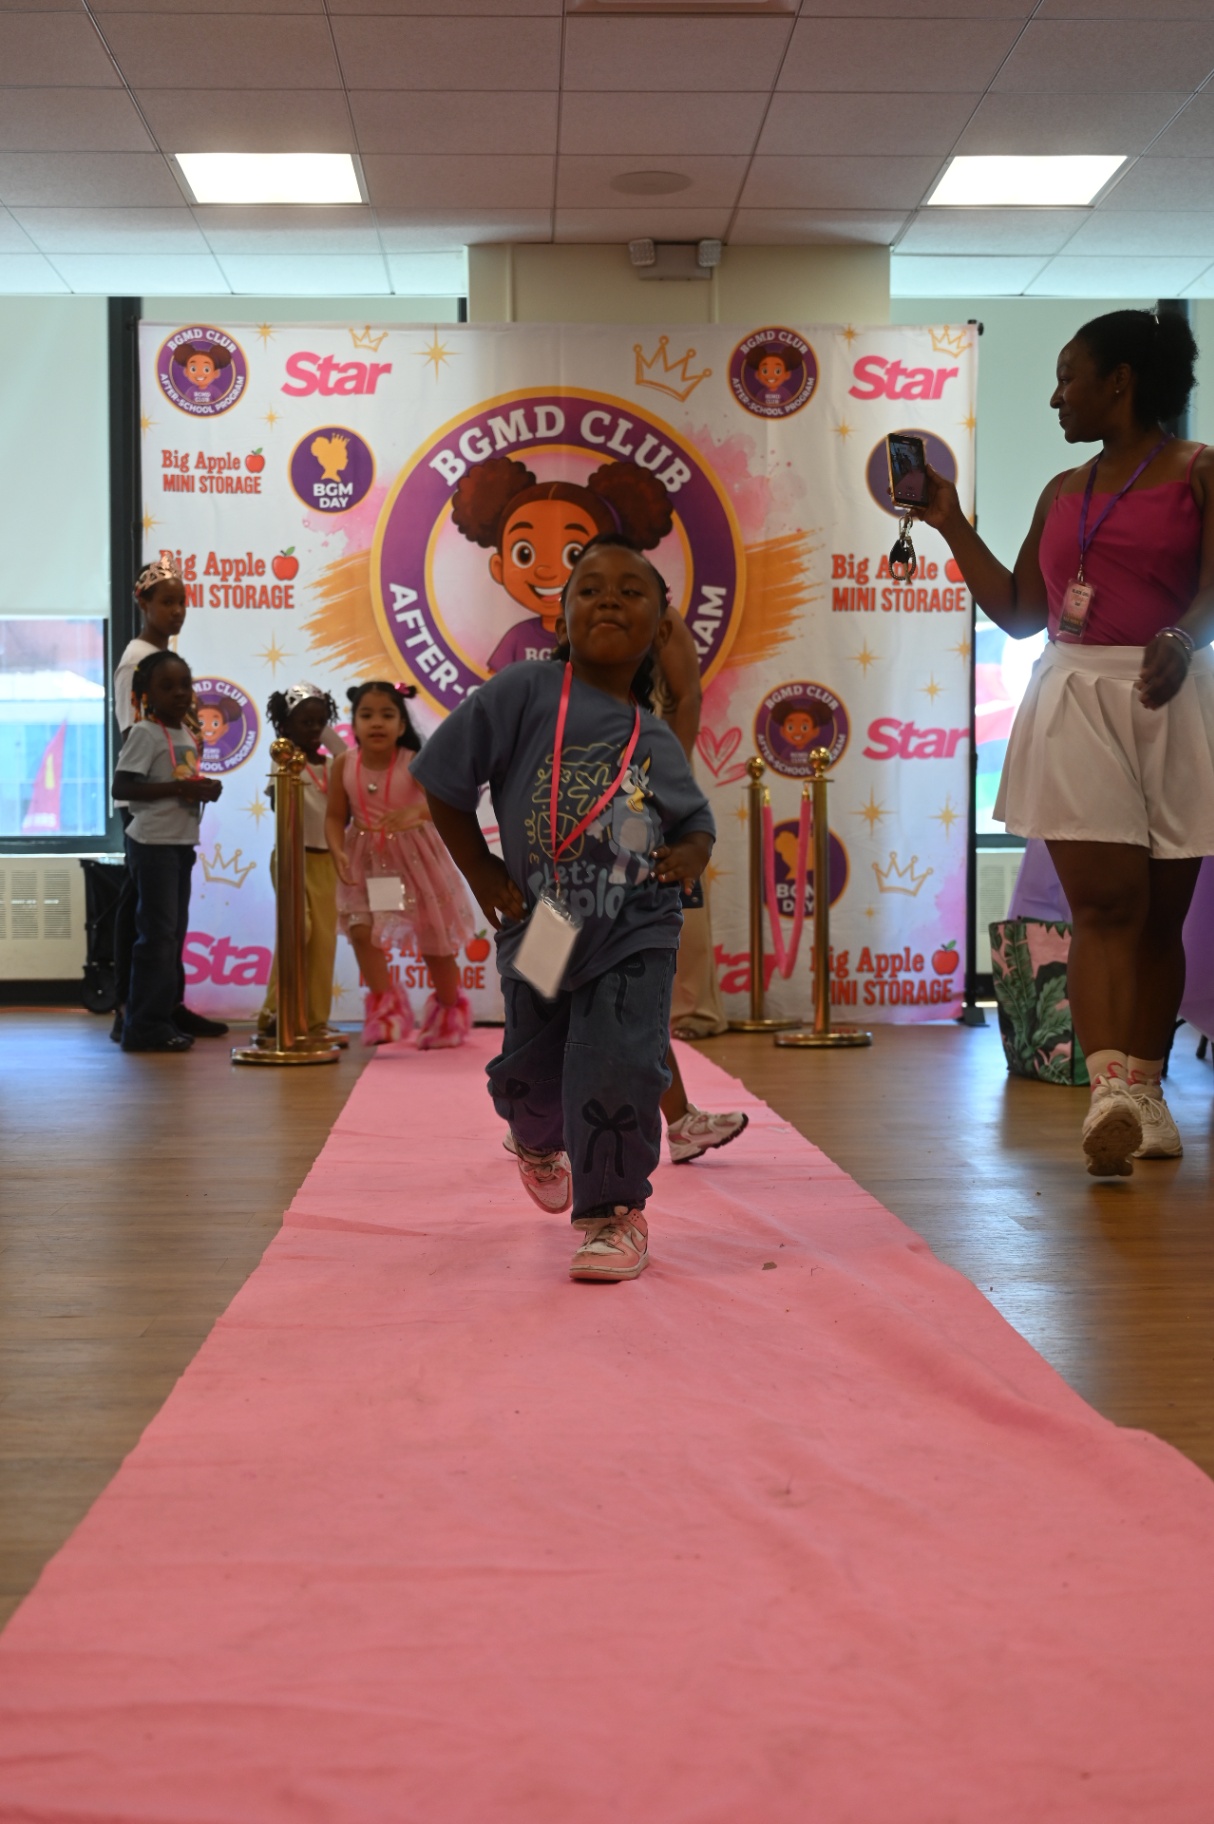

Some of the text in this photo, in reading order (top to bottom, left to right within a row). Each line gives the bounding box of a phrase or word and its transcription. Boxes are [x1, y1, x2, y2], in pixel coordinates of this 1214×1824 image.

[166, 328, 237, 353] BGMD CLUB
[740, 331, 808, 354] BGMD CLUB
[280, 351, 392, 397] Star
[848, 355, 959, 400] Star
[160, 373, 244, 414] AFTER-SCHOOL PROGRAM
[732, 377, 815, 415] AFTER-SCHOOL PROGRAM
[161, 450, 240, 473] Big Apple
[429, 405, 692, 493] BGMD CLUB
[163, 473, 261, 494] MINI STORAGE
[313, 482, 353, 497] BGM
[319, 497, 349, 508] DAY
[203, 551, 266, 582] Apple
[831, 553, 869, 585] Big
[185, 583, 295, 609] NI STORAGE
[832, 587, 966, 612] MINI STORAGE
[215, 682, 248, 707] CLUB
[764, 685, 839, 711] BGMD CLUB
[224, 730, 256, 768] PROGRAM
[862, 716, 970, 761] Star
[782, 899, 814, 912] DY
[182, 931, 273, 986] Sta
[856, 946, 924, 978] Apple
[864, 978, 953, 1006] STORAGE
